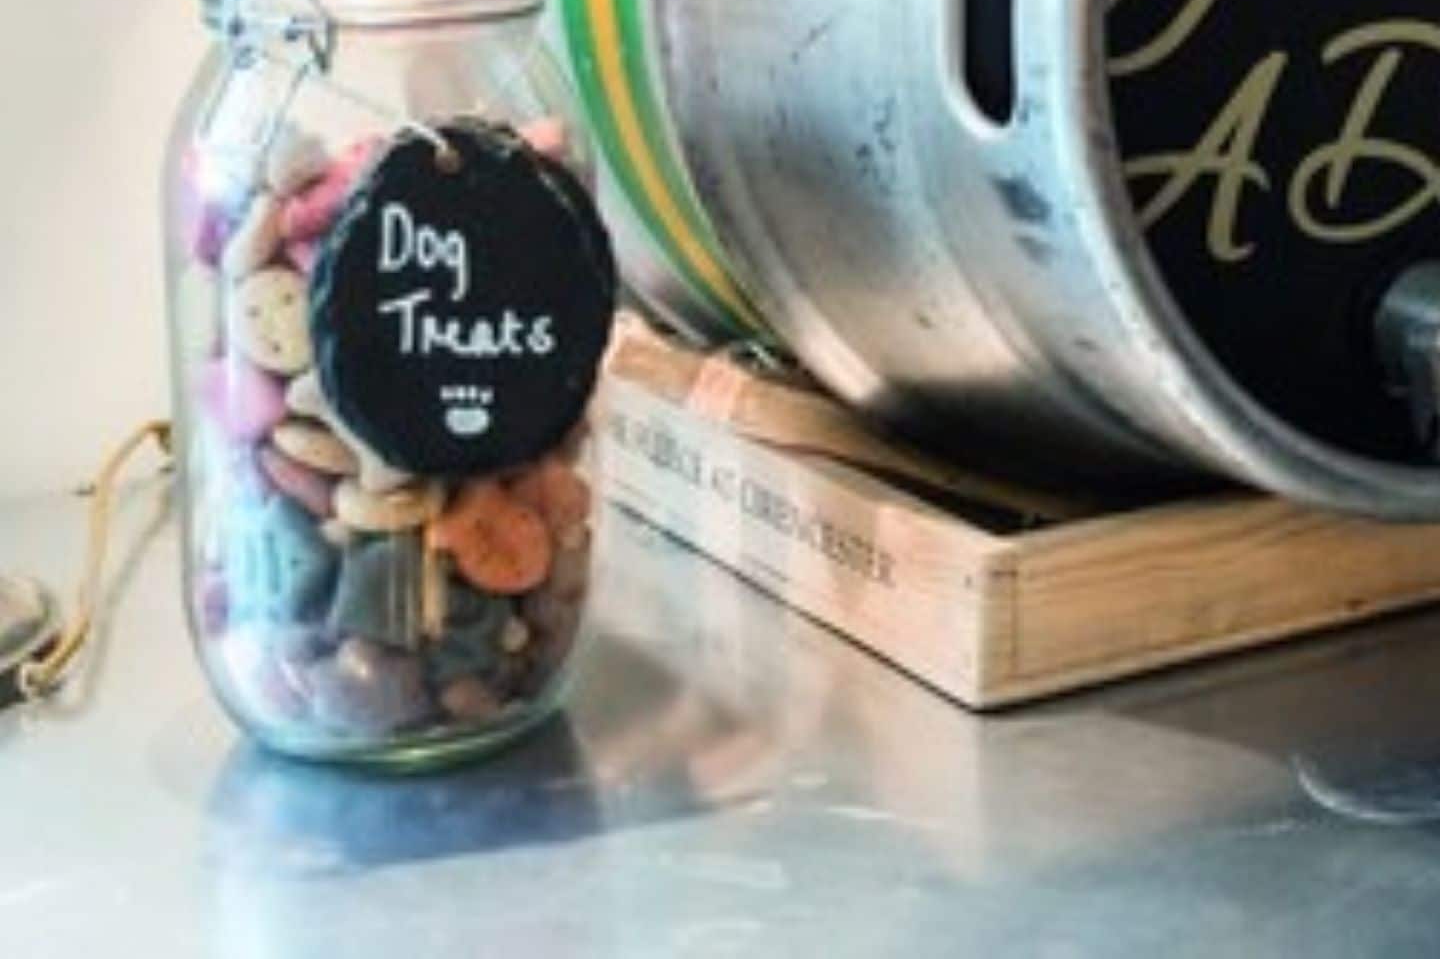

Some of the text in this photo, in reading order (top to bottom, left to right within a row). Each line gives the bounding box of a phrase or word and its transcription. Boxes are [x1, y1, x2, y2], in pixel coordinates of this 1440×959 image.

[1122, 51, 1290, 264] A
[377, 202, 468, 301] Dog
[377, 288, 556, 358] Treats
